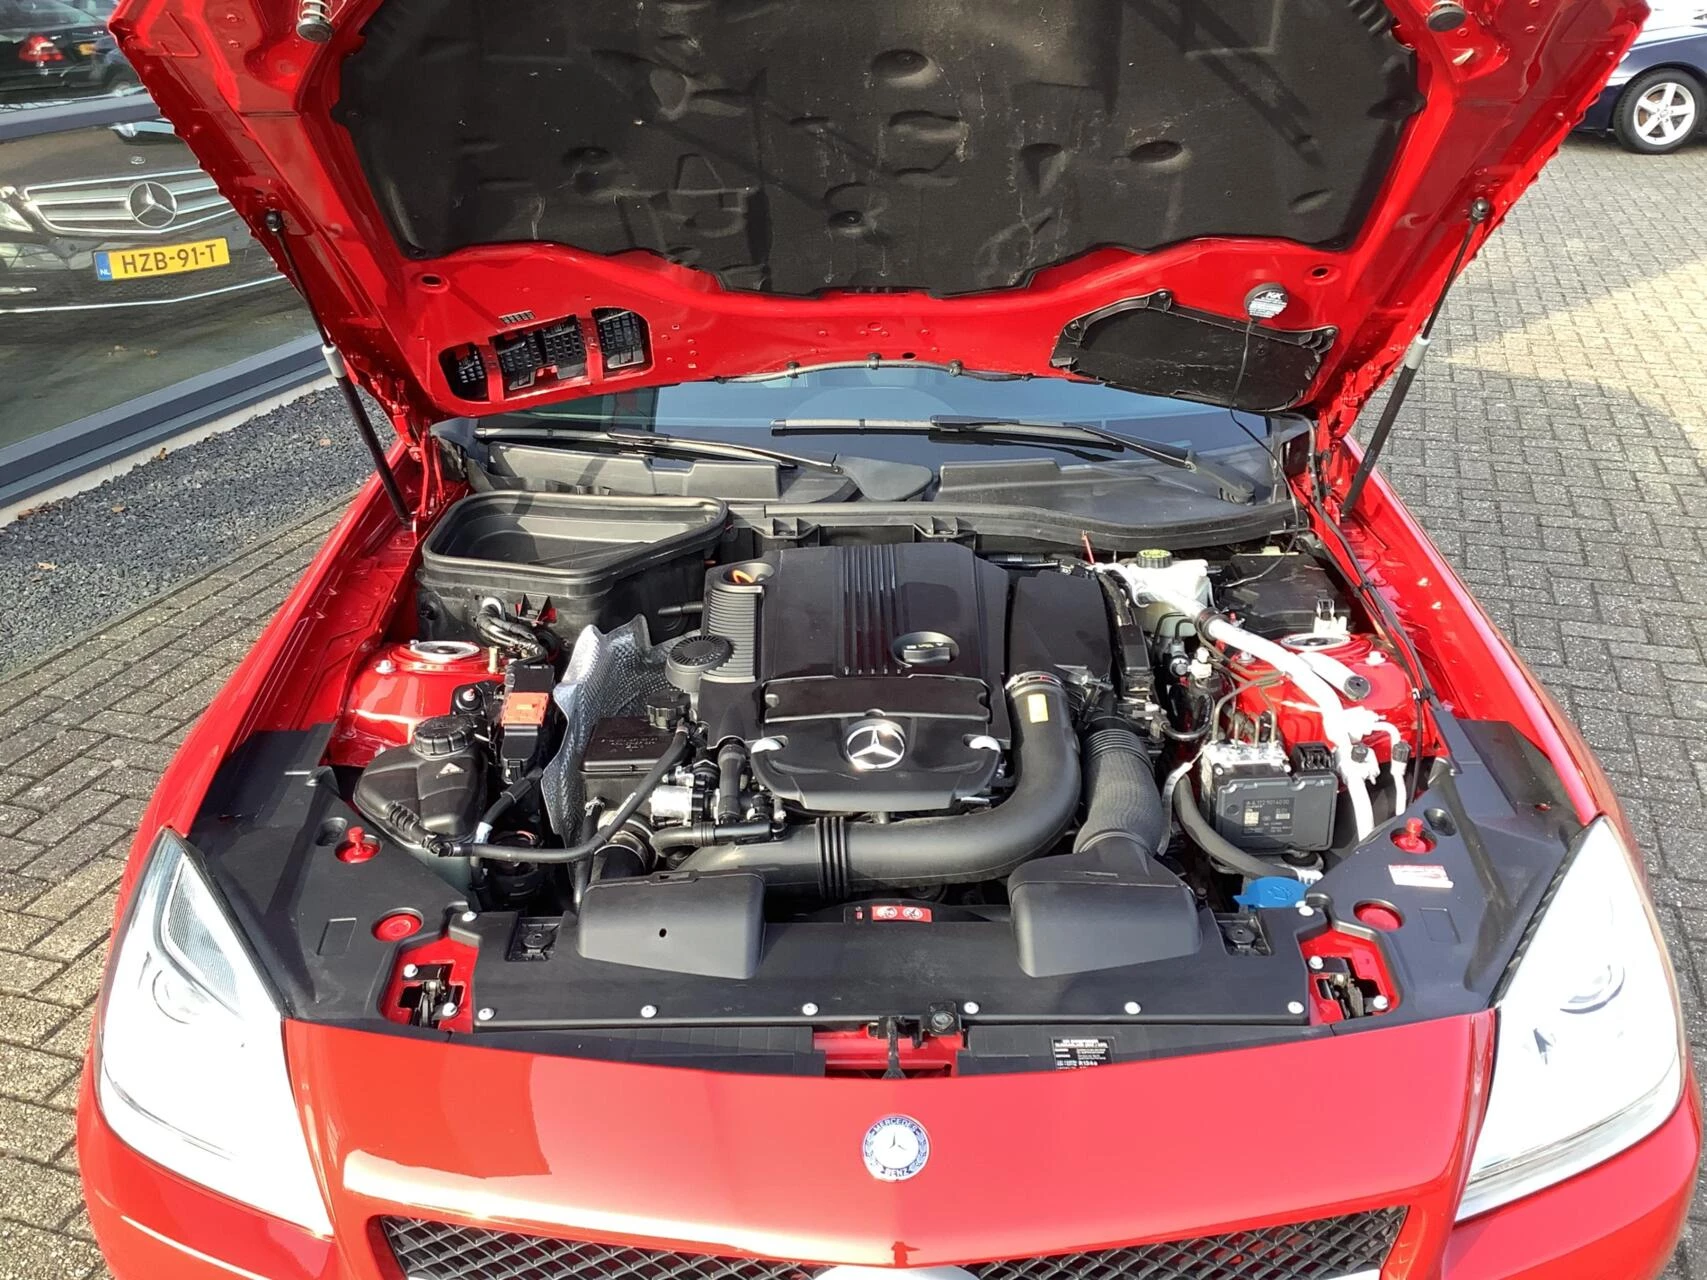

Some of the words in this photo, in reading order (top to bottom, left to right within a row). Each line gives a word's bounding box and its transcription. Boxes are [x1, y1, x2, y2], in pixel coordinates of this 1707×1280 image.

[122, 244, 216, 274] HZB-91-T
[874, 1117, 918, 1132] MERCEDES
[885, 1168, 908, 1177] BENZ
